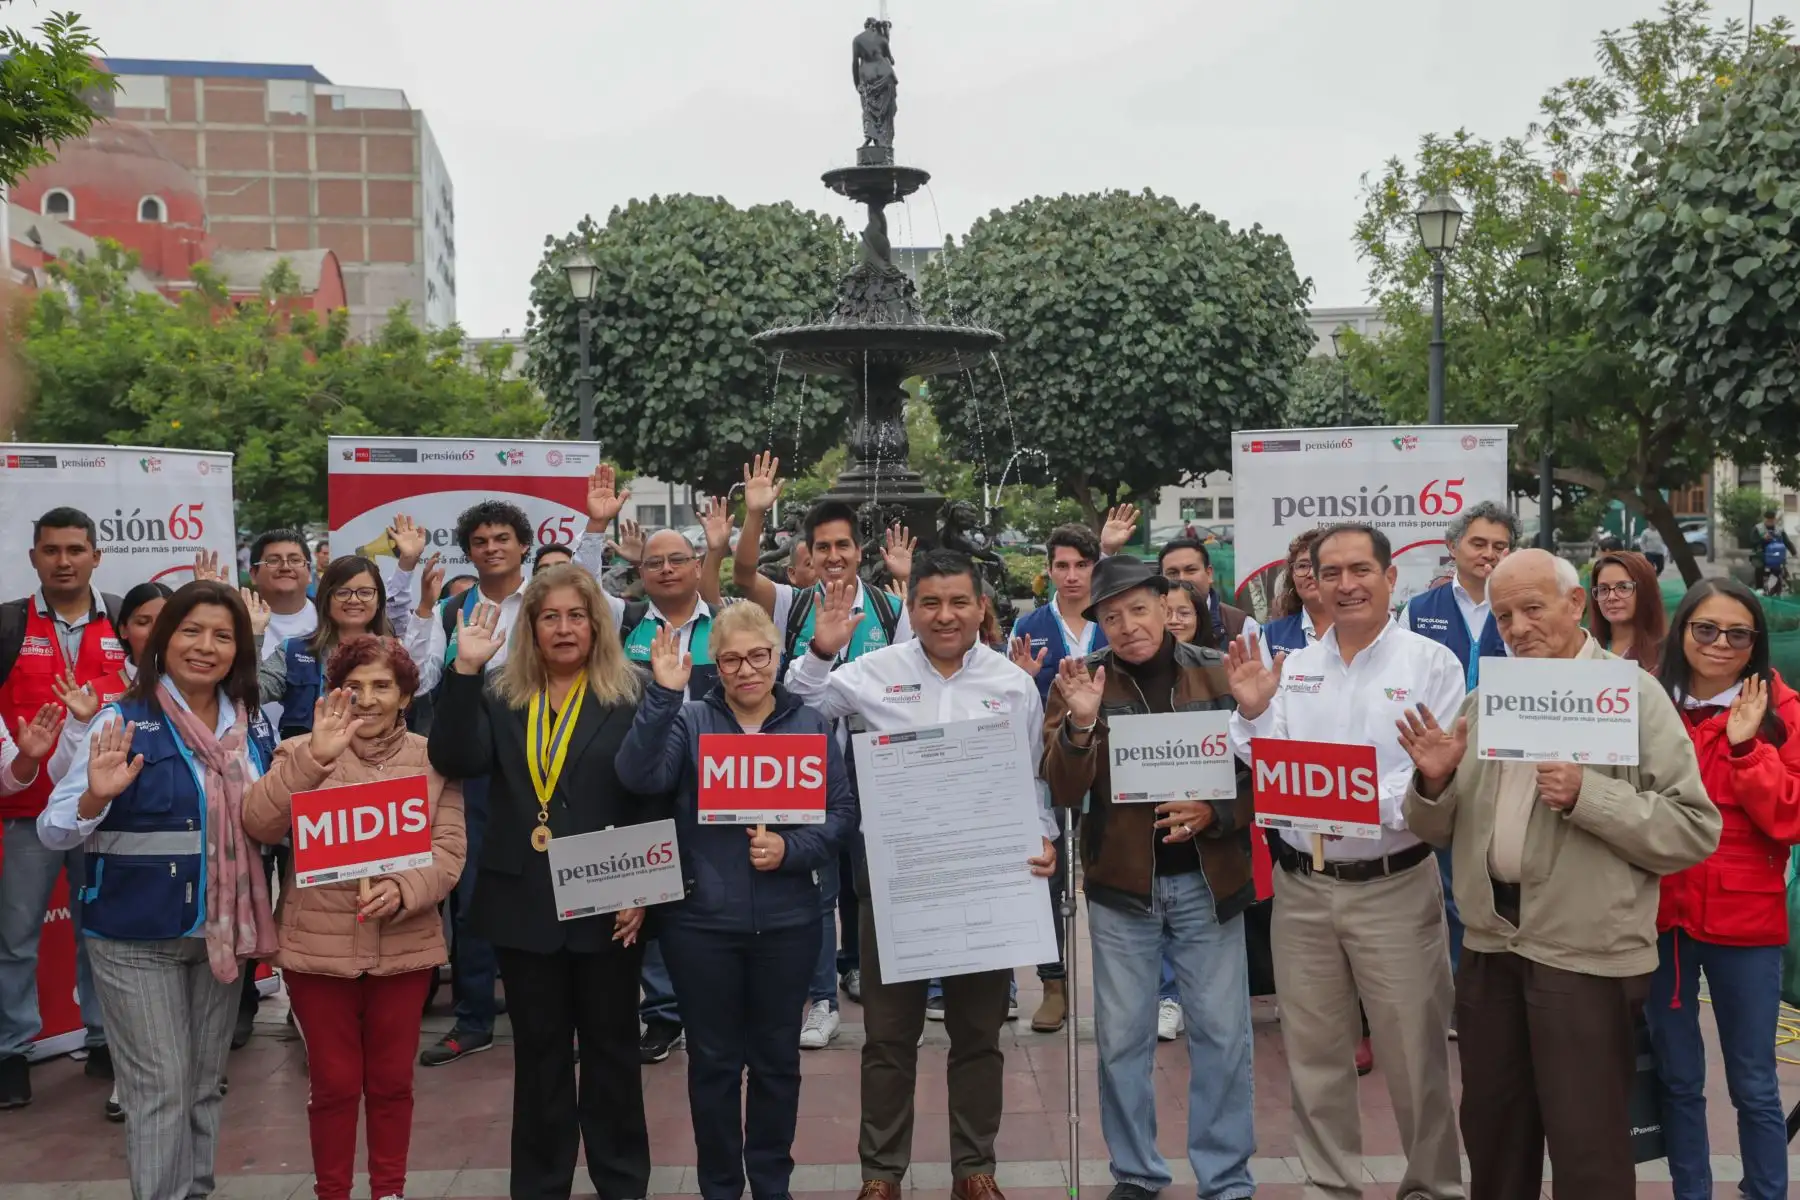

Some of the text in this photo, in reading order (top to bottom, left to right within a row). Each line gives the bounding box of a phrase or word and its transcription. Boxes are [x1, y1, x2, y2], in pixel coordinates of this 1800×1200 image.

[421, 449, 475, 462] pensión65
[1271, 477, 1465, 526] pensión65
[1485, 687, 1631, 716] pensión65
[1114, 732, 1228, 766] pensión65
[703, 755, 823, 790] MIDIS
[1256, 759, 1376, 802] MIDIS
[297, 798, 427, 850] MIDIS
[557, 840, 673, 887] pensión65
